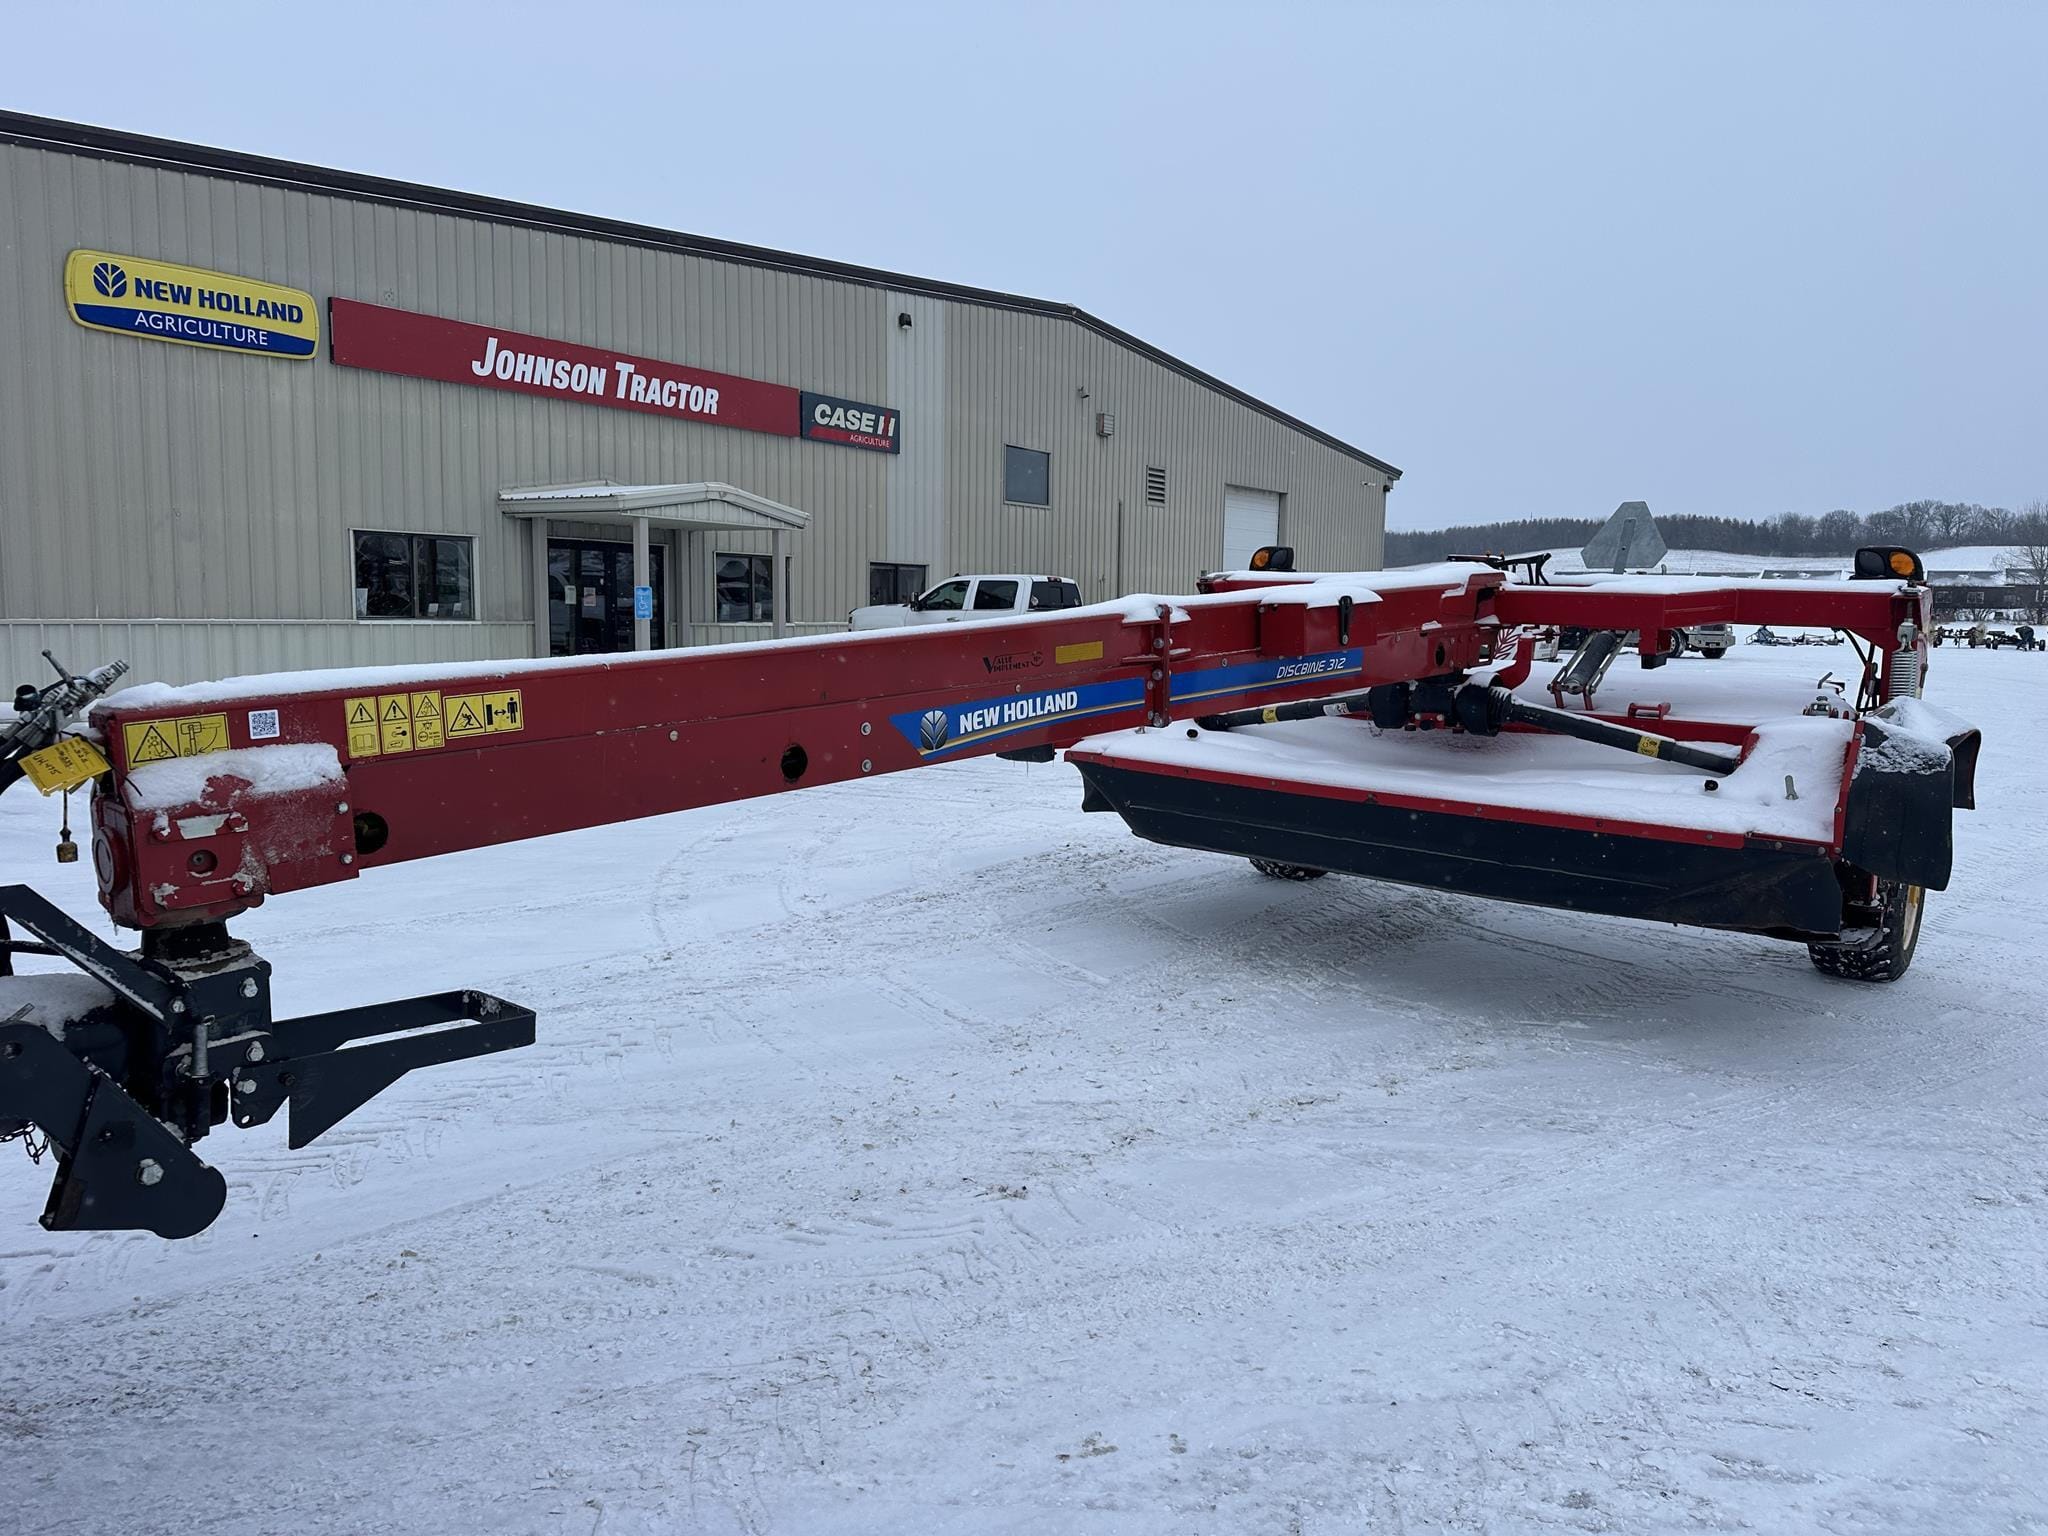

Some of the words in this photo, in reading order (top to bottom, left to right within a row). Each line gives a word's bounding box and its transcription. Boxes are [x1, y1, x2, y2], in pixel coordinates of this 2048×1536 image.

[134, 277, 192, 305] NEW
[198, 288, 303, 324] HOLLAND
[134, 311, 268, 346] AGRICULTURE
[471, 337, 607, 396] JOHNSON
[615, 361, 720, 415] TRACTOR
[814, 403, 876, 434] CASE
[849, 434, 890, 448] AGRICULTURE
[1276, 660, 1326, 679] DISCBINE
[1327, 657, 1346, 671] 312
[959, 706, 1000, 734] NEW
[1003, 691, 1078, 723] HOLLAND
